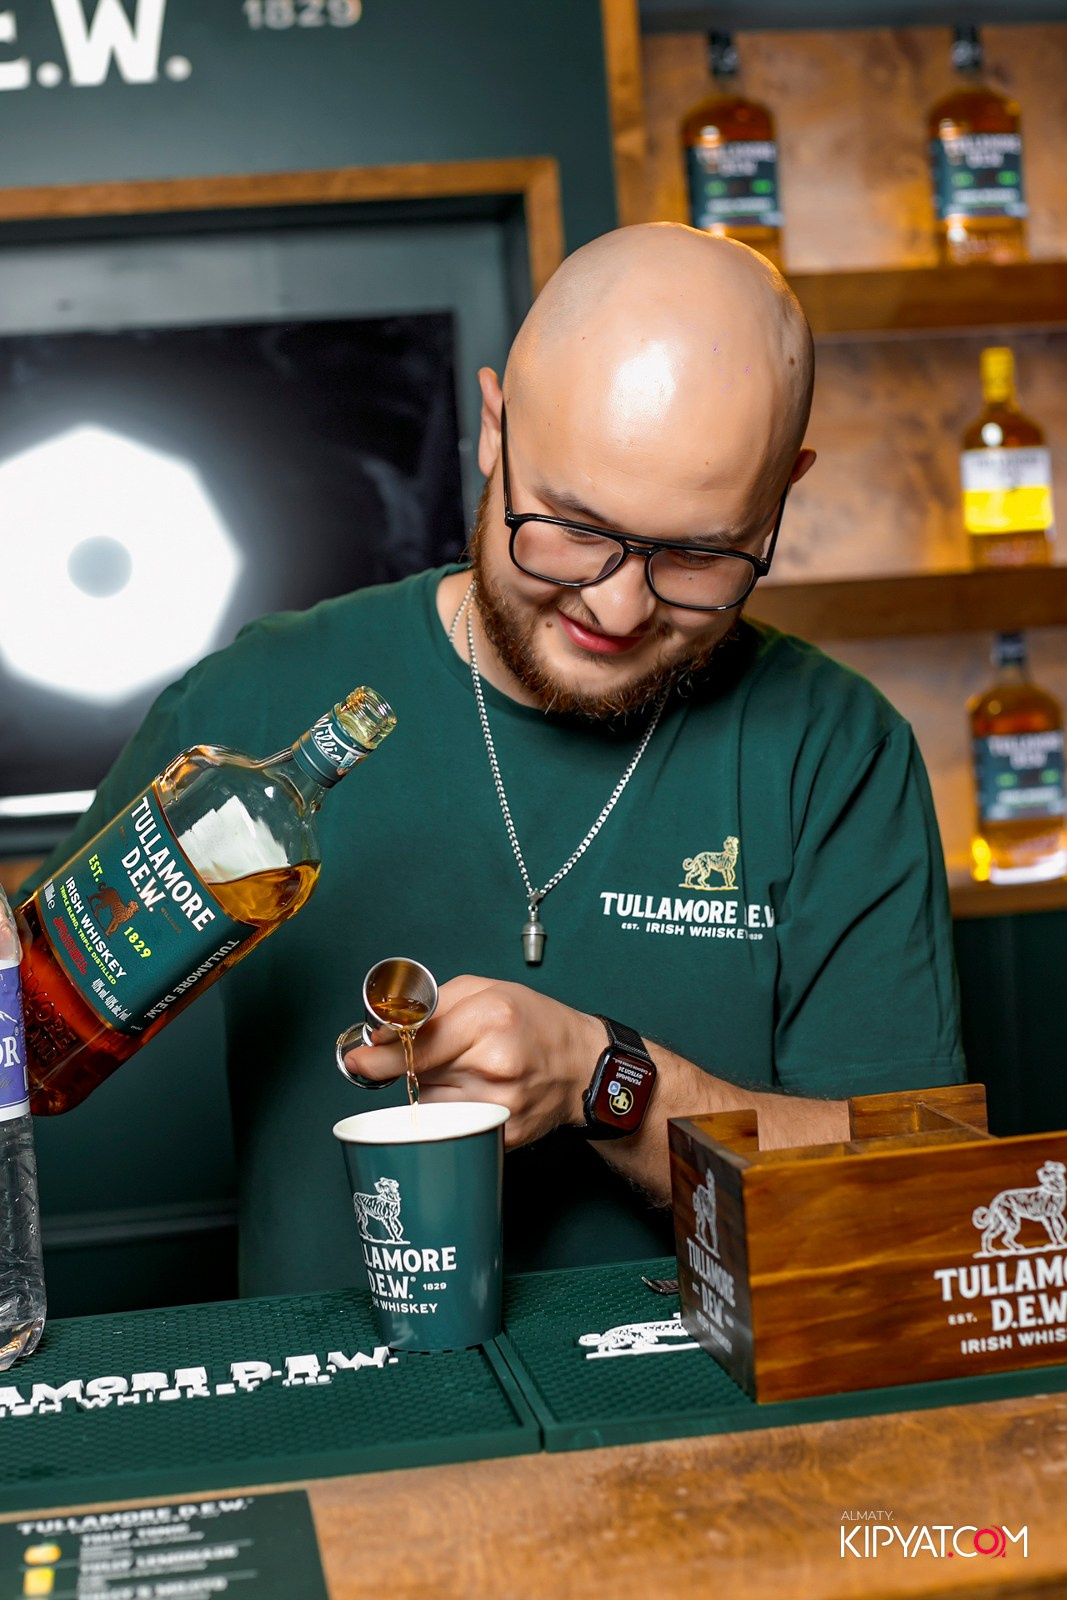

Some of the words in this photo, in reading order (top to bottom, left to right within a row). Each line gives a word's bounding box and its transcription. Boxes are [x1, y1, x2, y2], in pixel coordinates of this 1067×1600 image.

[88, 854, 104, 882] EST.
[122, 846, 166, 912] D.E.W.
[131, 796, 216, 931] TULLAMORE
[600, 892, 738, 924] TULLAMORE
[60, 885, 70, 906] TRIPLE
[78, 928, 93, 953] TRIPLE
[91, 952, 116, 985] DISTILLED
[66, 876, 84, 914] IRISH
[80, 914, 127, 978] WHISKEY
[124, 926, 152, 958] 1829
[621, 922, 640, 930] EST.
[646, 922, 684, 936] IRISH
[173, 940, 240, 994] TULLAMORE
[422, 1282, 446, 1290] 1829
[380, 1300, 438, 1314] WHISKEY
[961, 1334, 1012, 1354] IRISH
